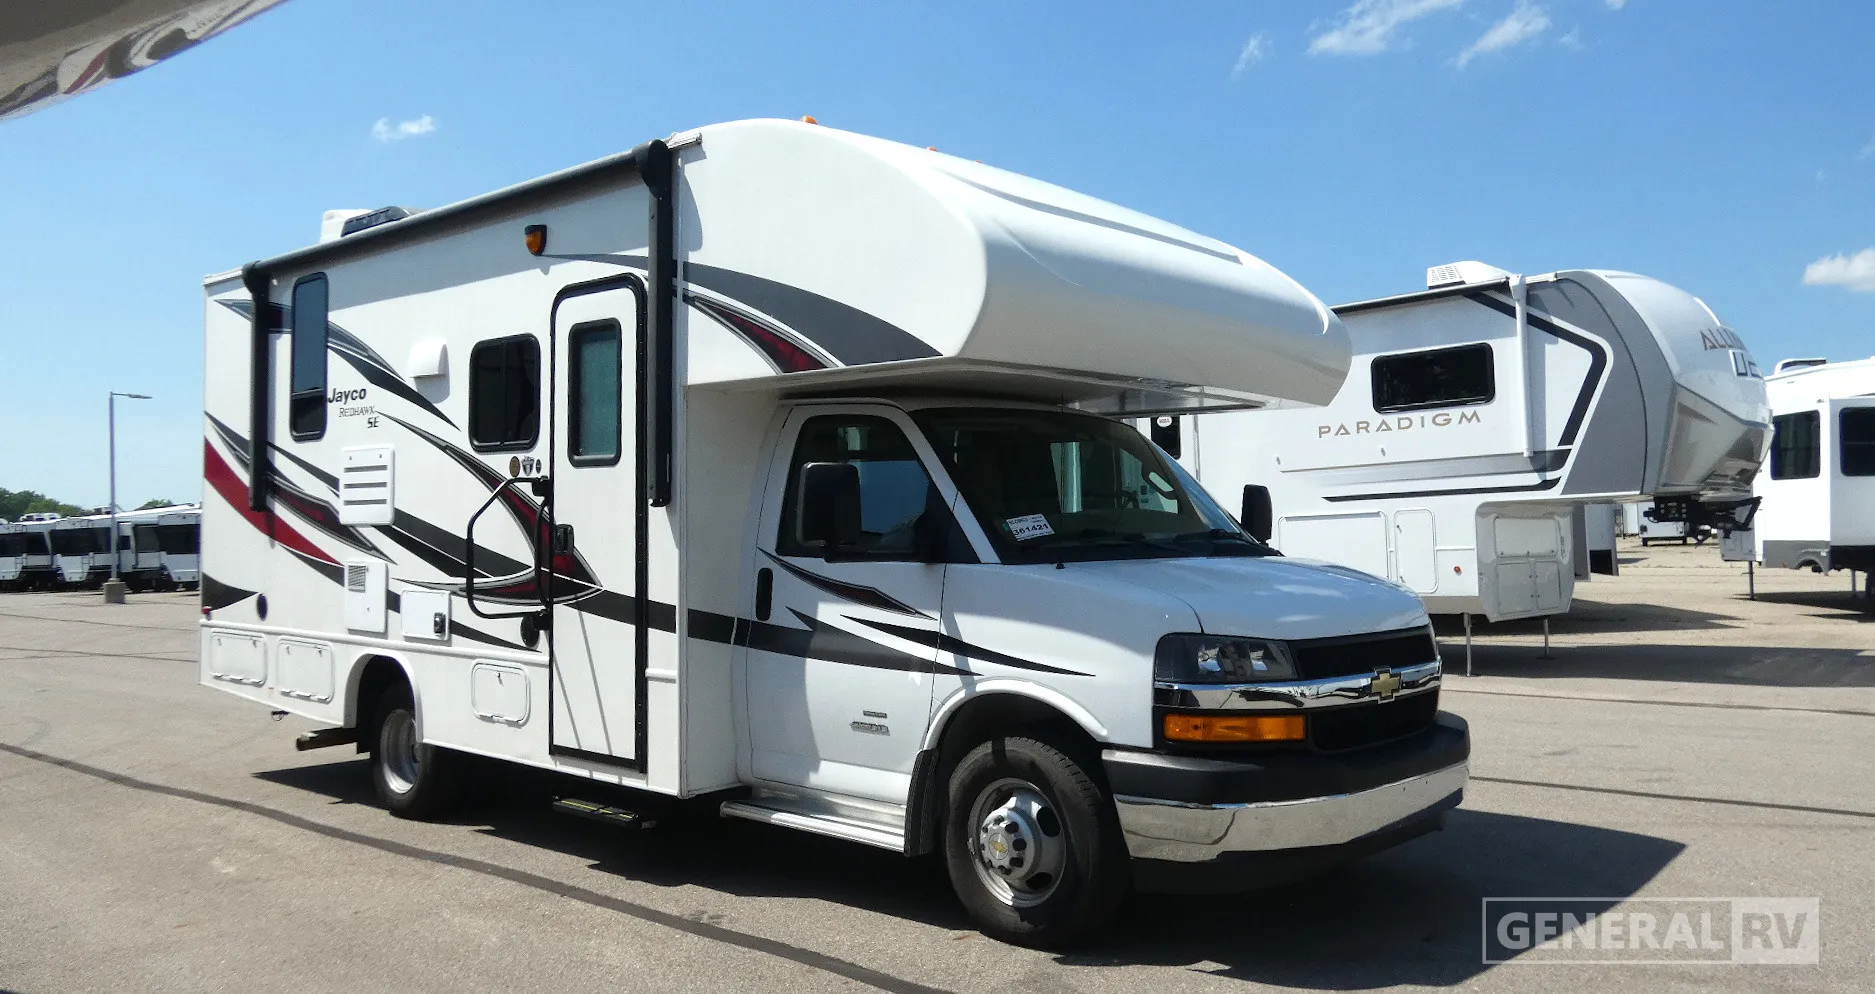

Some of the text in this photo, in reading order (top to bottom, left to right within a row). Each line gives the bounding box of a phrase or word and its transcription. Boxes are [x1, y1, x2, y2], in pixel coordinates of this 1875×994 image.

[328, 388, 367, 405] Jayco
[339, 406, 375, 418] REDHAWK
[367, 416, 379, 428] SE
[1318, 410, 1481, 438] PARADIGM
